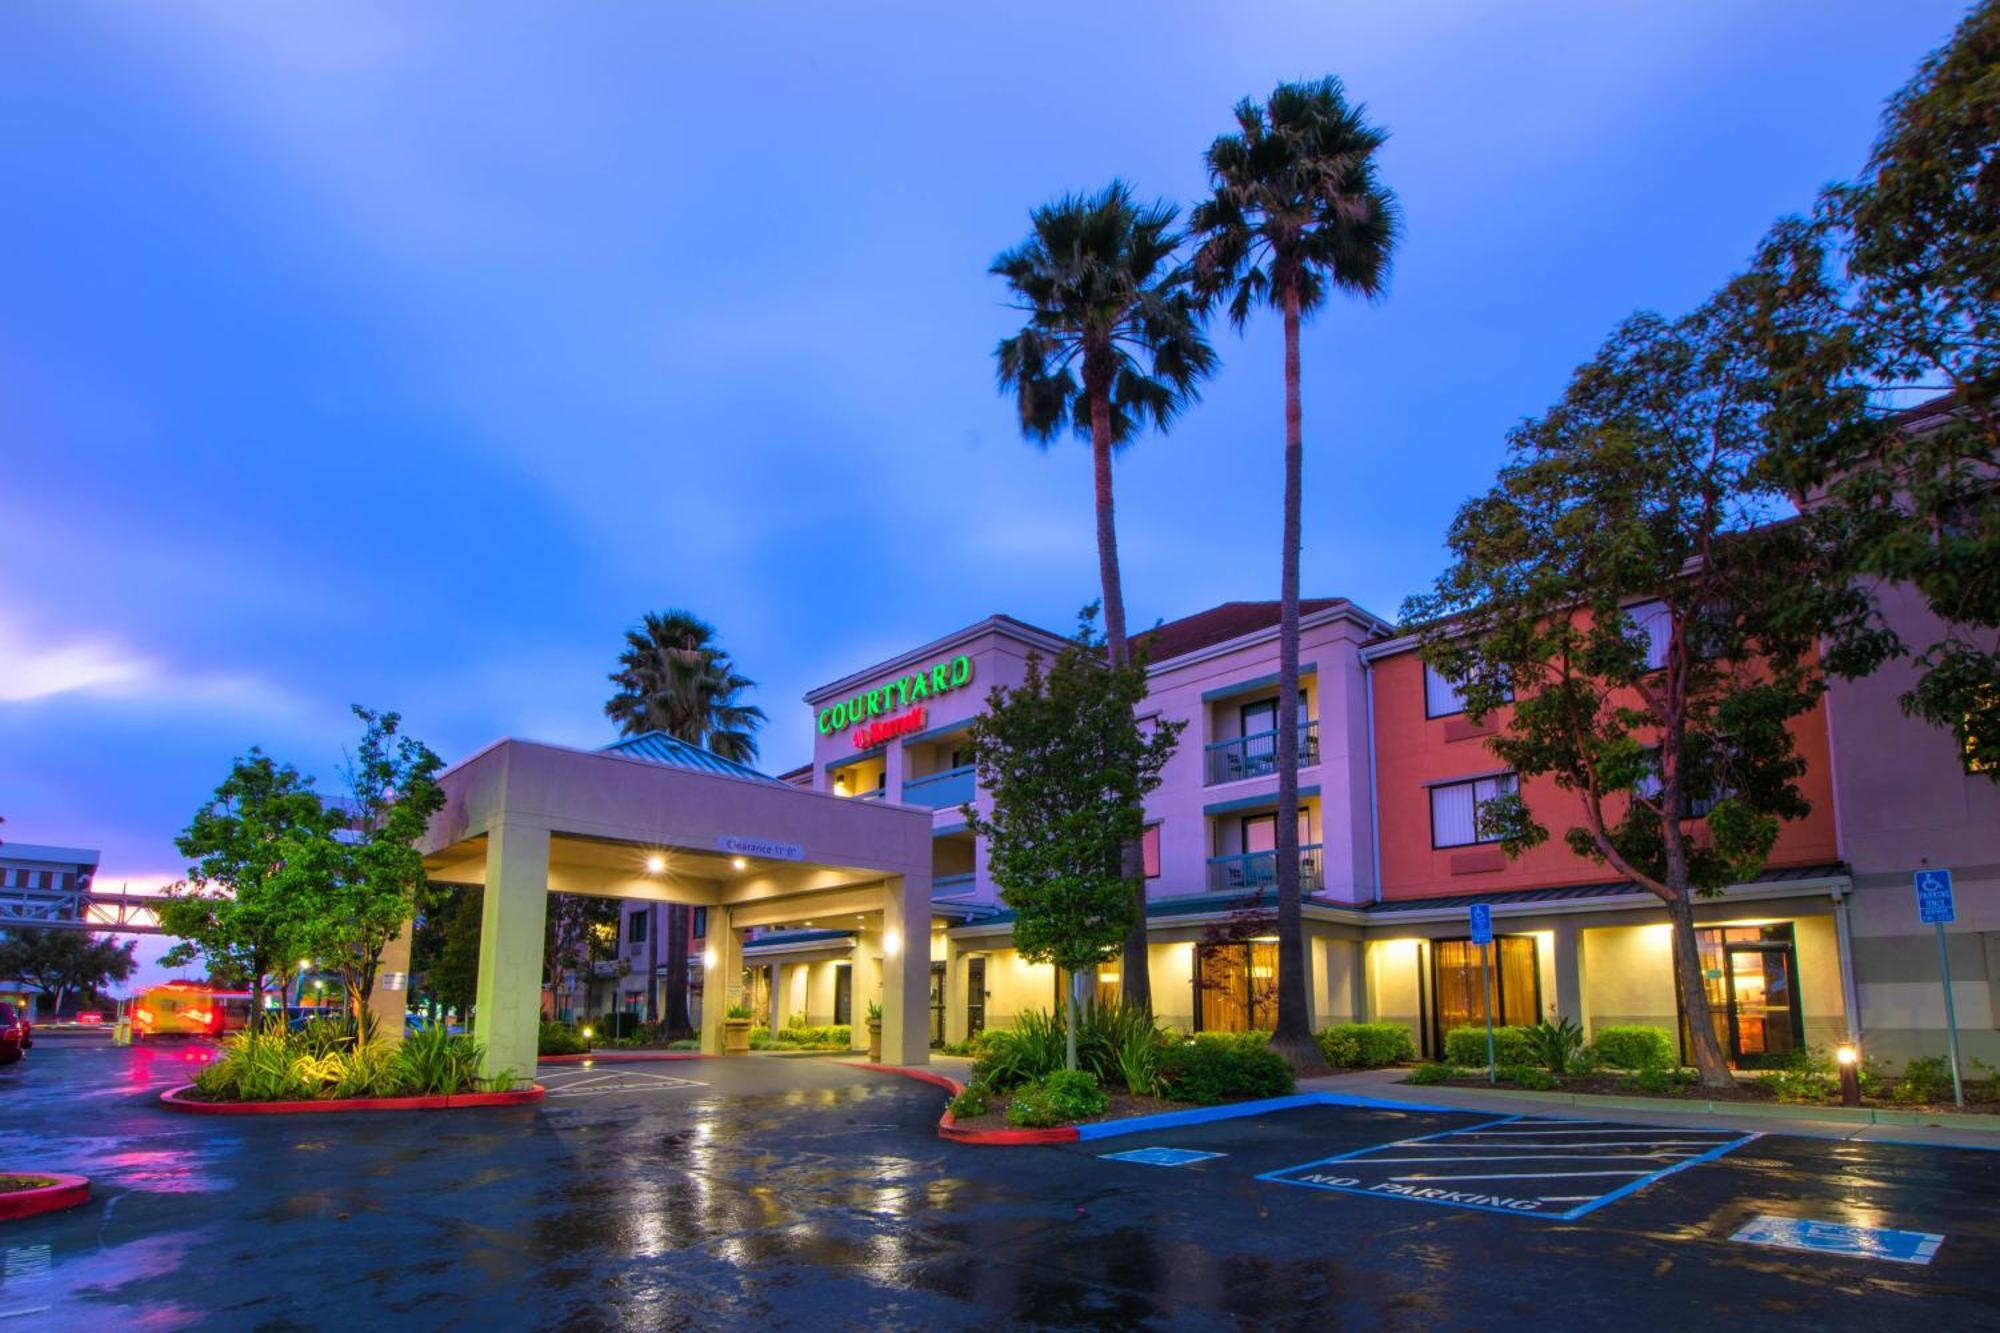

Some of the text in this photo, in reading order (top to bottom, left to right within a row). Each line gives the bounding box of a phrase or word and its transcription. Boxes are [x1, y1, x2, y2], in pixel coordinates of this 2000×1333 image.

[818, 655, 971, 736] COURTYARD
[726, 839, 771, 855] Clearance
[1300, 1173, 1542, 1210] NO PARKING
